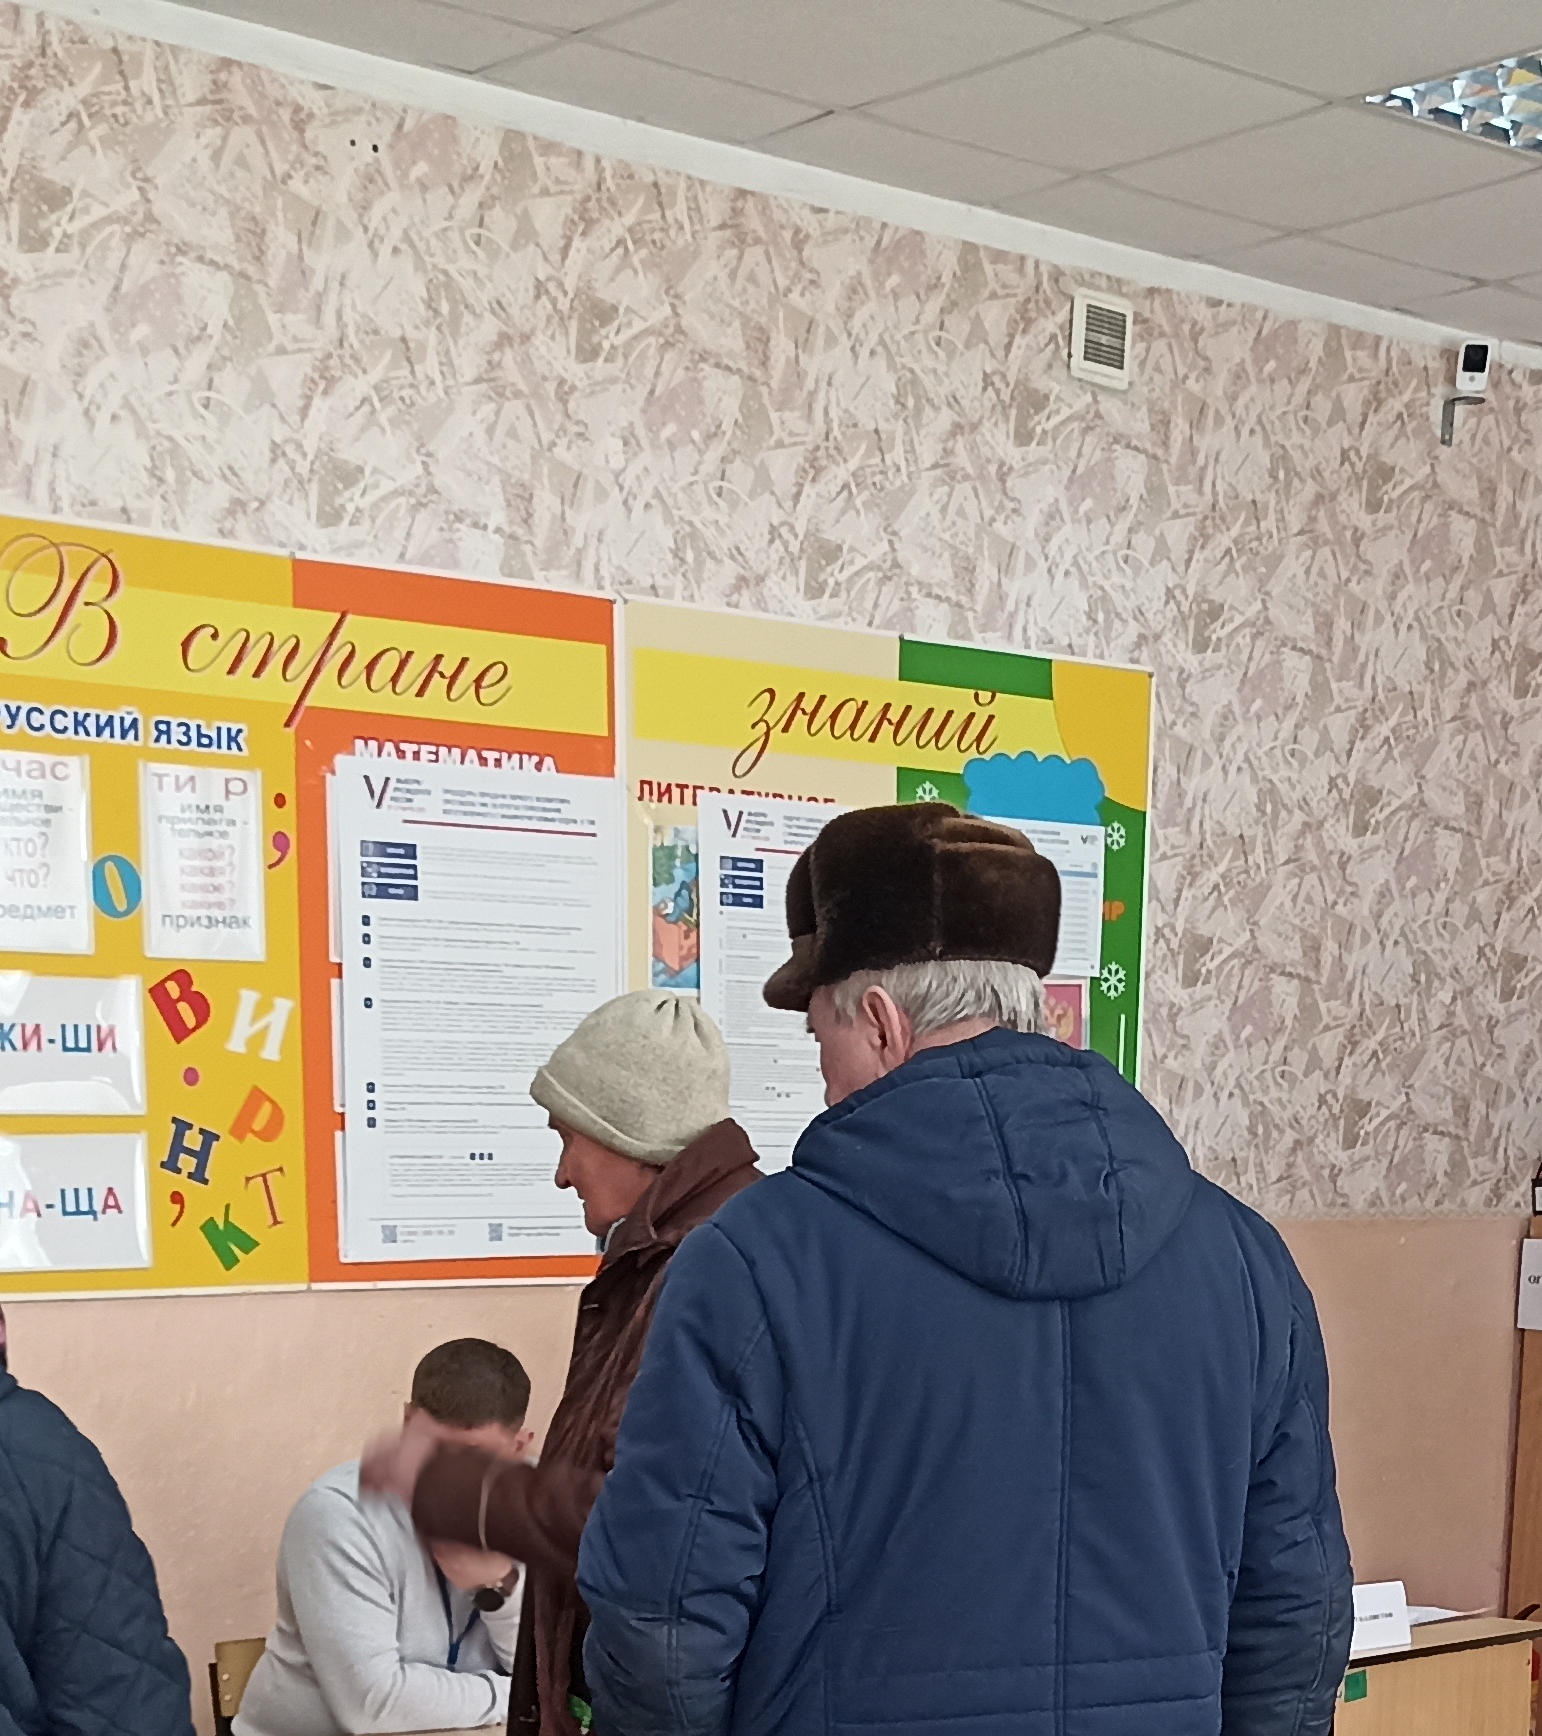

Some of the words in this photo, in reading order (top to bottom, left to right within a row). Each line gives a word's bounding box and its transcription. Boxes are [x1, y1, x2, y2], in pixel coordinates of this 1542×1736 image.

[180, 609, 512, 728] стране
[153, 719, 244, 752] ЯЗЫК
[731, 687, 1000, 779] знаний
[353, 738, 559, 774] МАТЕМАТИКА
[0, 758, 71, 782] час
[151, 772, 197, 794] ти
[179, 803, 225, 815] имя
[4, 831, 50, 859] кто?
[4, 862, 51, 889] что?
[161, 914, 253, 933] признак
